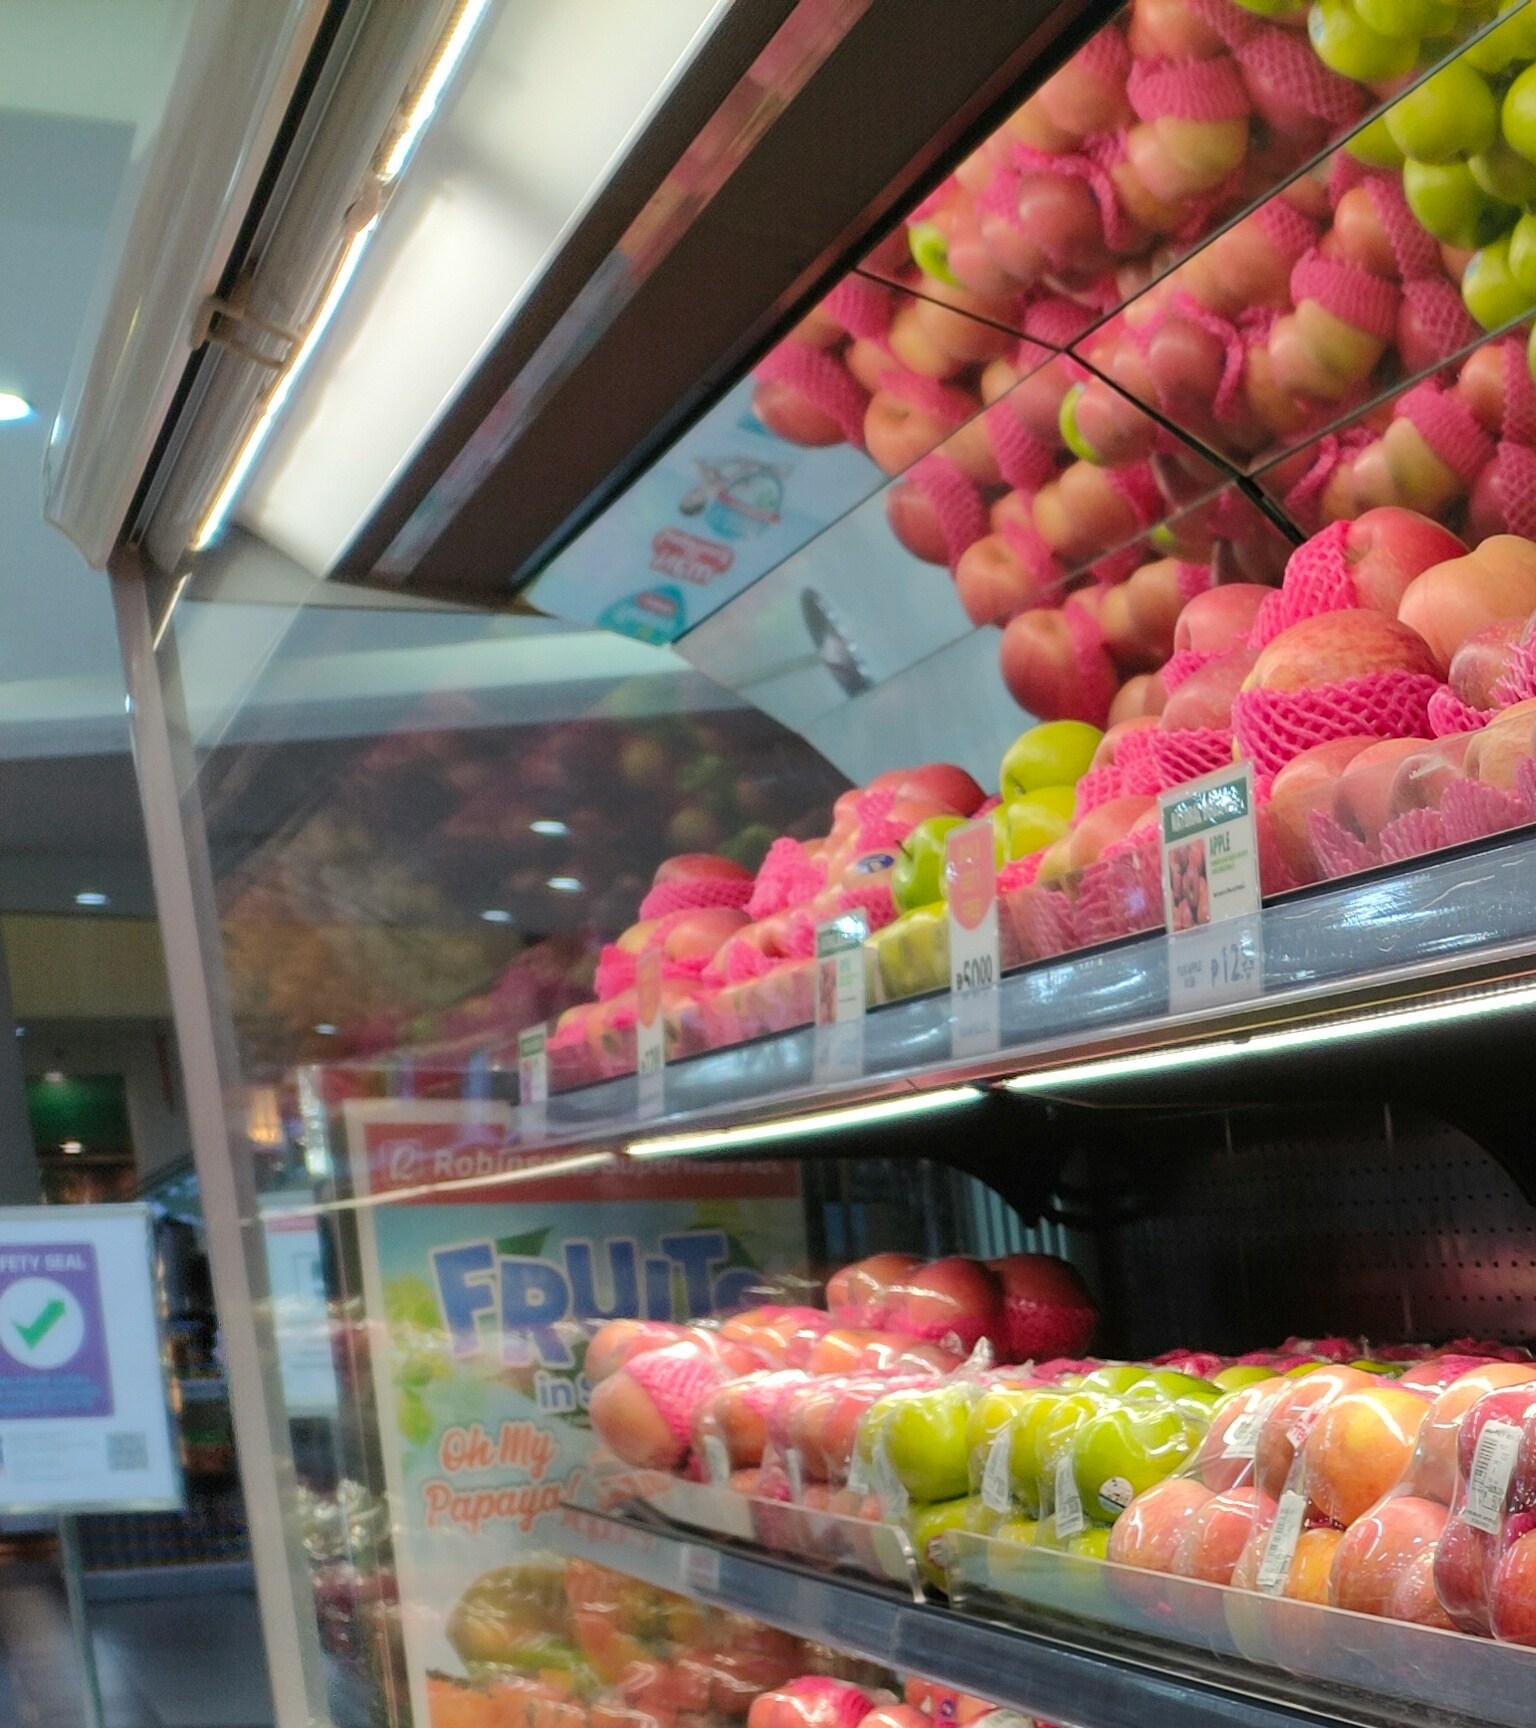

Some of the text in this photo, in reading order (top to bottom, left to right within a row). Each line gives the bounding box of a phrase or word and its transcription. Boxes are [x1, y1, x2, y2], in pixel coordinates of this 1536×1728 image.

[45, 1253, 86, 1271] SEAL
[538, 1373, 575, 1411] in
[441, 1420, 555, 1481] Oh My
